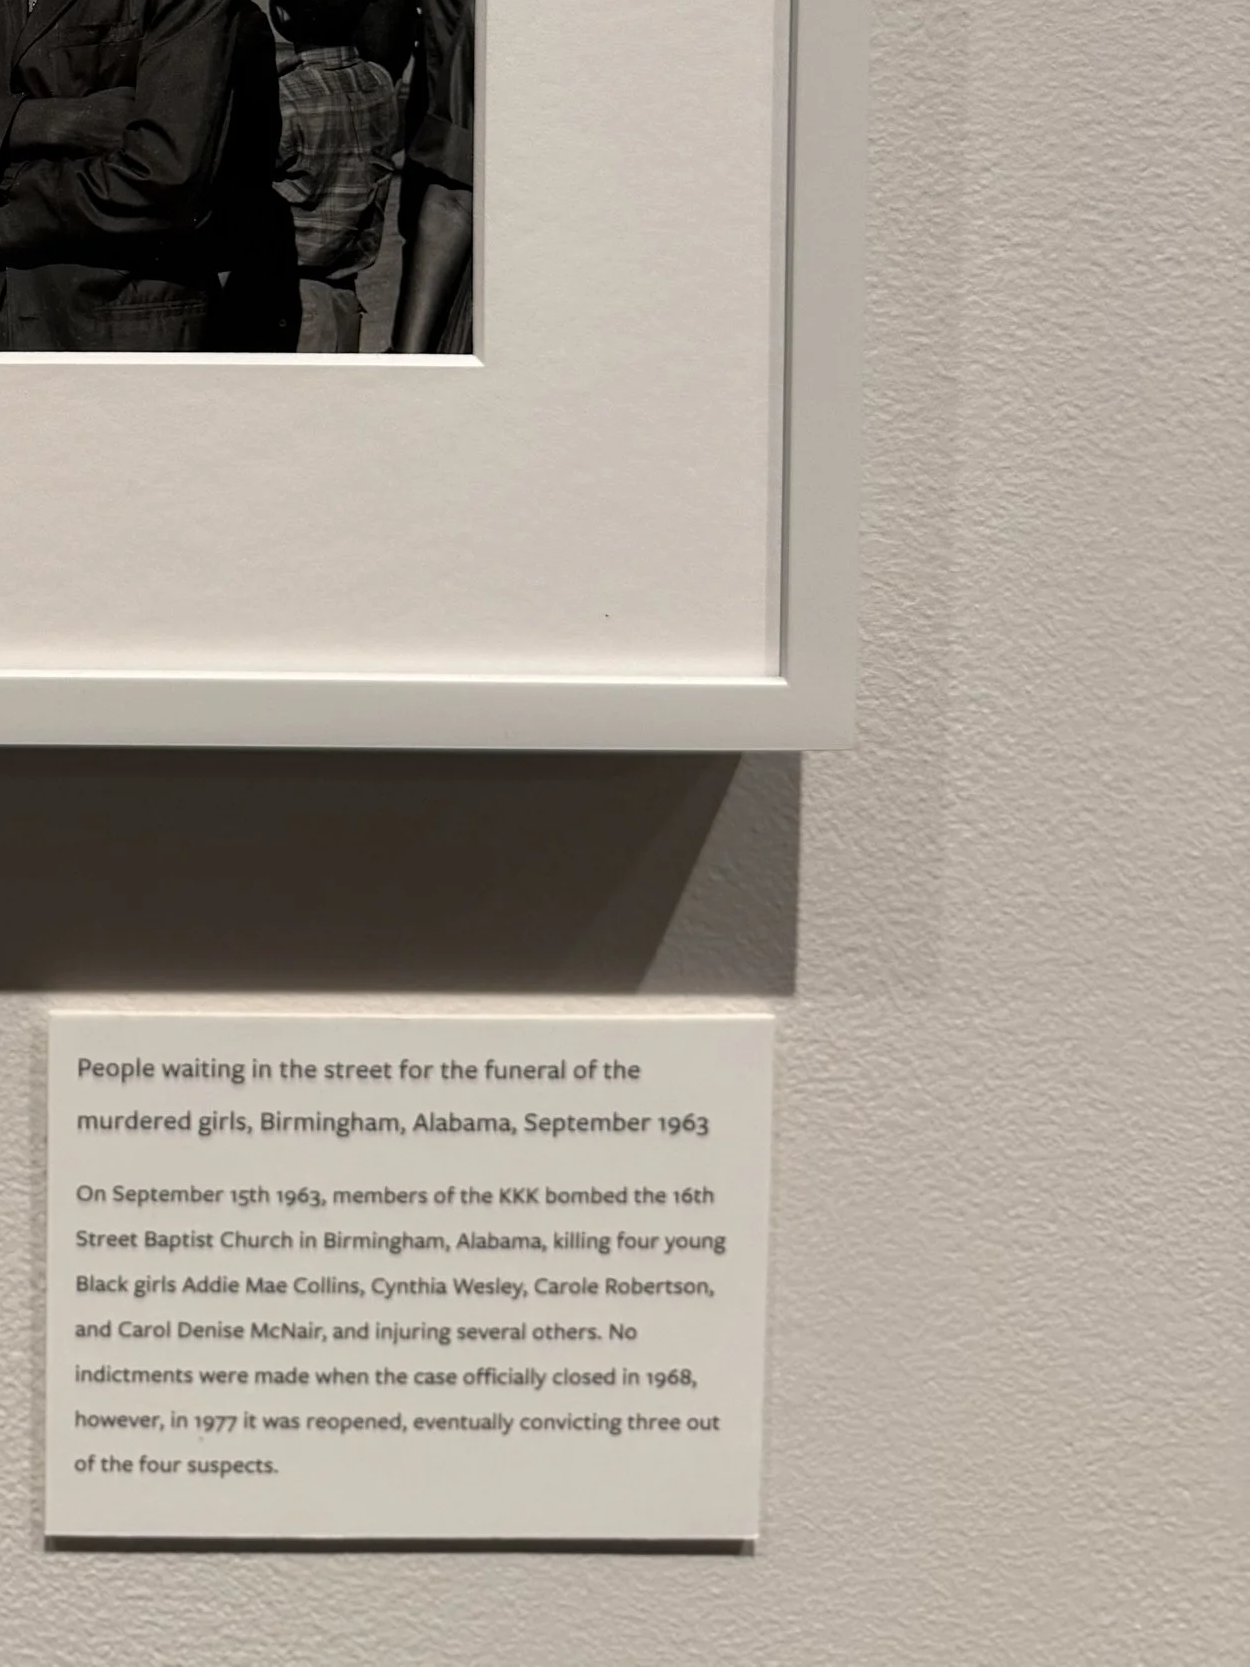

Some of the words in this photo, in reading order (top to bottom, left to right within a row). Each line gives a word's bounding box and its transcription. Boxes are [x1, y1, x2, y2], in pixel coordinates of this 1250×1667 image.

[77, 1056, 156, 1085] People
[161, 1057, 246, 1087] waiting
[251, 1057, 273, 1080] in
[278, 1057, 319, 1081] the
[323, 1061, 393, 1082] street
[398, 1058, 435, 1081] for
[439, 1059, 479, 1082] the
[483, 1058, 567, 1082] funeral
[572, 1058, 599, 1082] of
[602, 1058, 642, 1082] the
[76, 1109, 192, 1132] murdered
[197, 1110, 254, 1139] girls,
[260, 1110, 407, 1140] Birmingham,
[411, 1111, 518, 1137] Alabama,
[523, 1110, 653, 1139] September
[657, 1112, 710, 1138] 1963
[75, 1184, 107, 1204] On
[112, 1184, 225, 1208] September
[229, 1185, 271, 1209] 15th
[276, 1186, 328, 1209] 1963,
[332, 1185, 429, 1206] members
[433, 1185, 457, 1206] of
[459, 1185, 494, 1207] the
[498, 1187, 540, 1206] KKK
[545, 1185, 629, 1206] bombed
[633, 1186, 668, 1206] the
[672, 1185, 715, 1206] 16th
[75, 1229, 139, 1249] Street
[144, 1229, 215, 1254] Baptist
[219, 1230, 294, 1250] Church
[299, 1230, 318, 1250] in
[323, 1230, 452, 1257] Birmingham,
[455, 1231, 548, 1253] Alabama,
[553, 1231, 612, 1257] killing
[616, 1230, 660, 1251] four
[663, 1235, 727, 1257] young
[75, 1274, 129, 1295] Black
[132, 1274, 177, 1300] girls
[181, 1275, 241, 1295] Addie
[245, 1276, 289, 1296] Mae
[292, 1275, 367, 1299] Collins,
[370, 1276, 449, 1301] Cynthia
[452, 1276, 529, 1302] Wesley,
[533, 1276, 600, 1297] Carole
[604, 1276, 715, 1299] Robertson,
[74, 1319, 113, 1339] and
[117, 1320, 172, 1340] Carol
[177, 1320, 245, 1341] Denise
[250, 1321, 328, 1343] McNair,
[332, 1321, 370, 1341] and
[375, 1321, 452, 1347] injuring
[456, 1321, 527, 1342] several
[531, 1322, 603, 1342] others.
[608, 1323, 638, 1342] No
[74, 1364, 194, 1385] indictments
[198, 1370, 250, 1385] were
[254, 1366, 311, 1386] made
[314, 1366, 370, 1386] when
[374, 1366, 409, 1387] the
[413, 1371, 459, 1387] case
[462, 1366, 548, 1392] officially
[551, 1367, 617, 1387] closed
[622, 1367, 641, 1386] in
[646, 1368, 698, 1390] 1968,
[74, 1409, 166, 1433] however,
[170, 1410, 189, 1429] in
[193, 1415, 239, 1436] 1977
[243, 1410, 257, 1431] it
[261, 1415, 301, 1431] was
[306, 1412, 408, 1435] reopened,
[412, 1412, 515, 1436] eventually
[519, 1412, 623, 1437] convicting
[626, 1412, 682, 1432] three
[685, 1415, 721, 1432] out
[73, 1453, 97, 1473] of
[99, 1454, 134, 1474] the
[138, 1454, 183, 1474] four
[186, 1458, 279, 1479] suspects.
